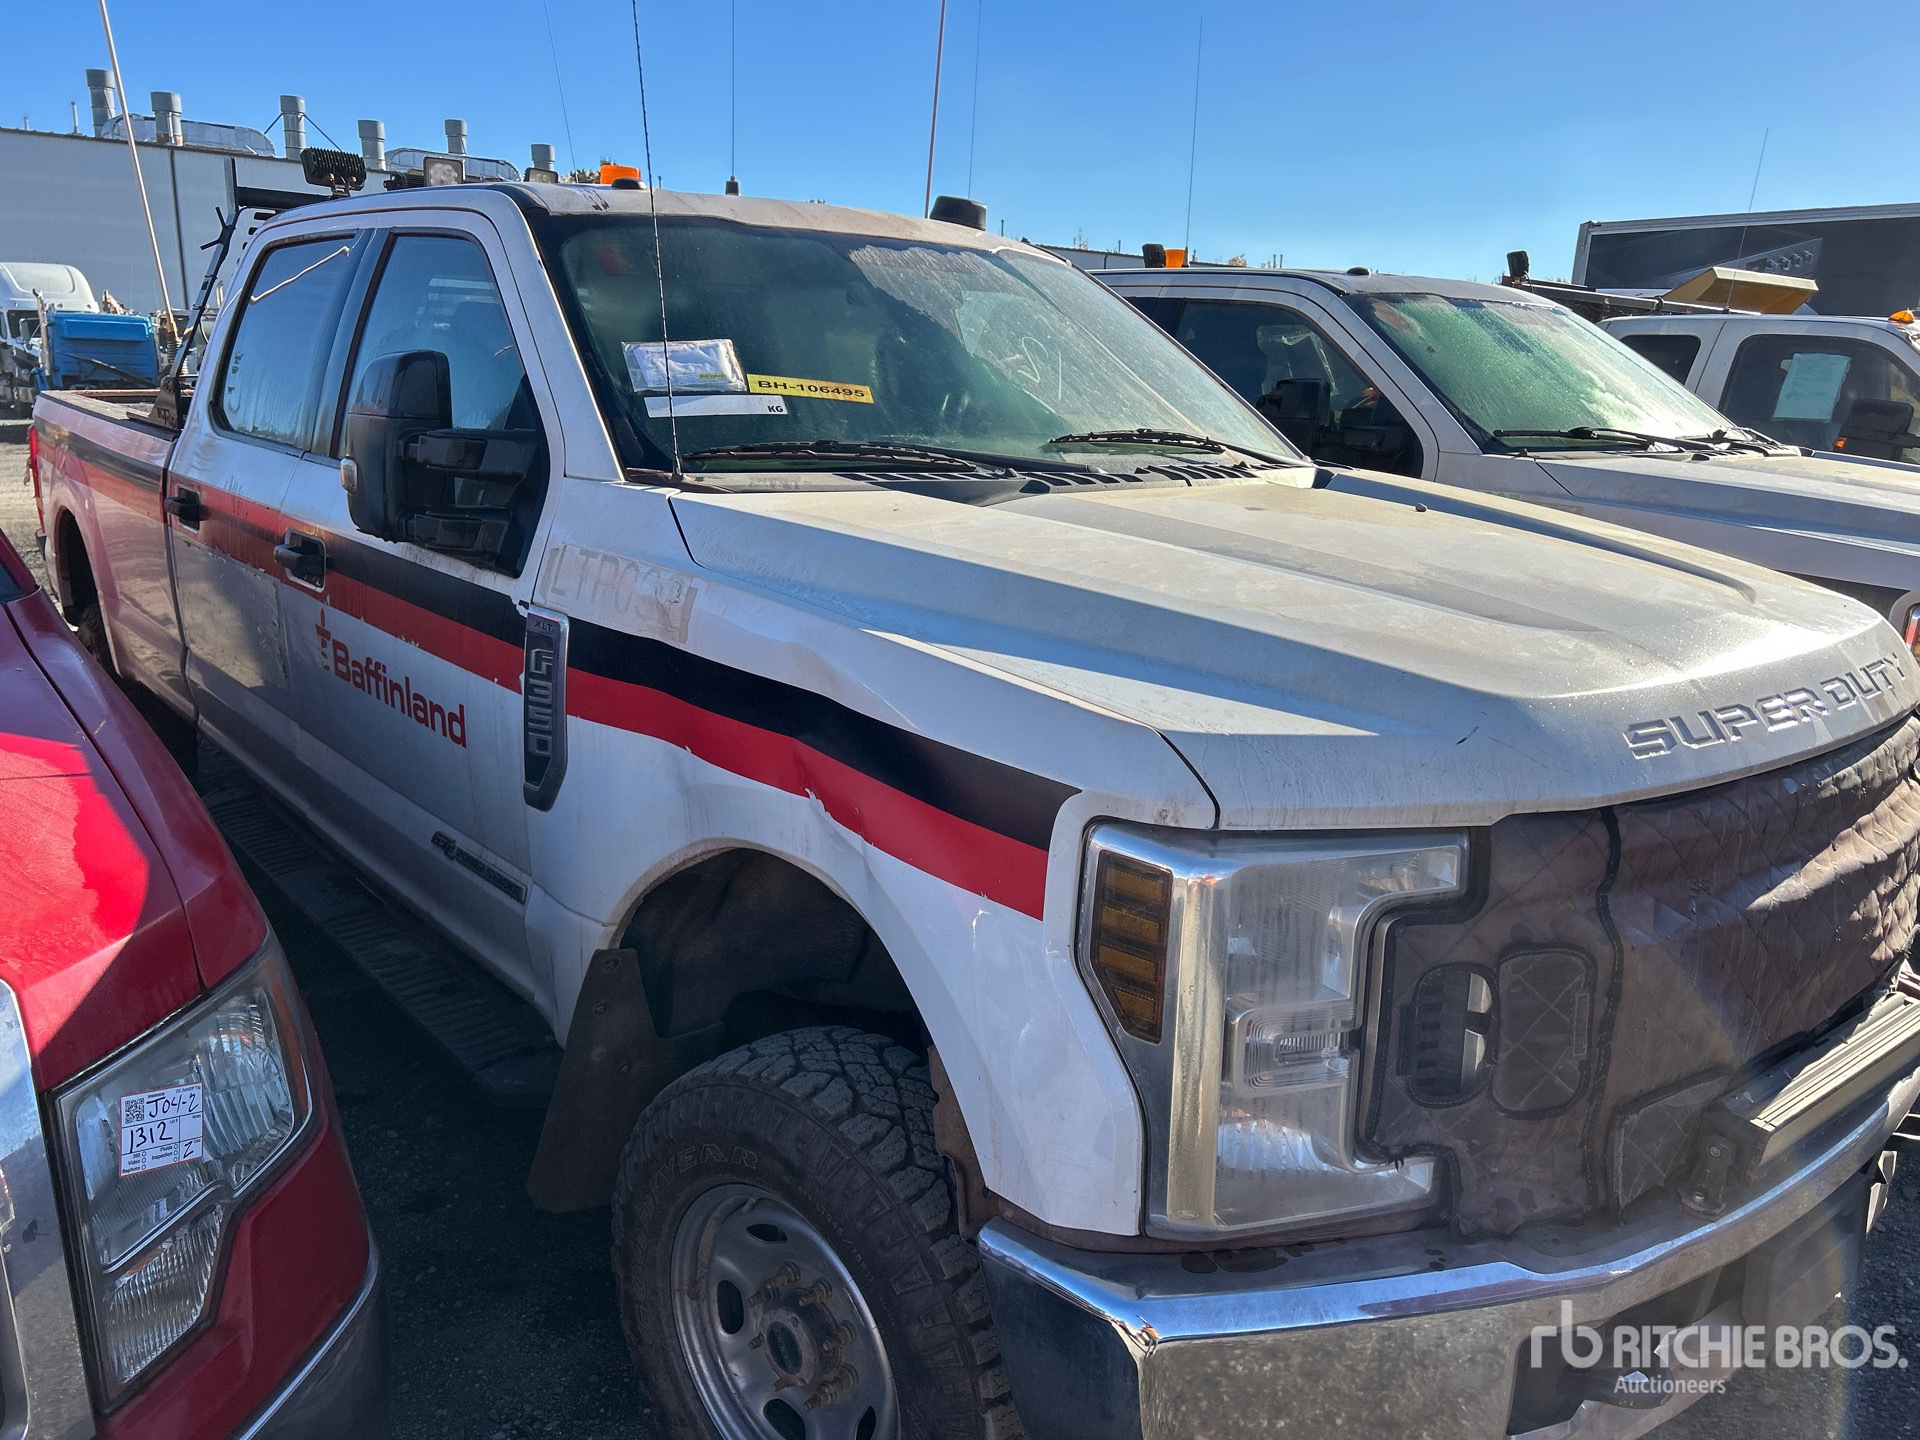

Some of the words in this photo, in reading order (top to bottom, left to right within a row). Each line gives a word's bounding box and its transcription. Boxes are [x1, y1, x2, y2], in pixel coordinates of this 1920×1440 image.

[758, 380, 865, 398] BH-106495
[767, 405, 783, 413] KG
[534, 620, 552, 632] XLT
[332, 638, 467, 749] Baffinland
[528, 648, 554, 757] F350
[1622, 687, 1829, 760] SUPER
[1820, 652, 1906, 710] DUTY
[146, 1093, 199, 1118] J04-2
[130, 1121, 173, 1154] 1312
[127, 1158, 141, 1166] Video
[151, 1151, 173, 1161] Inspection
